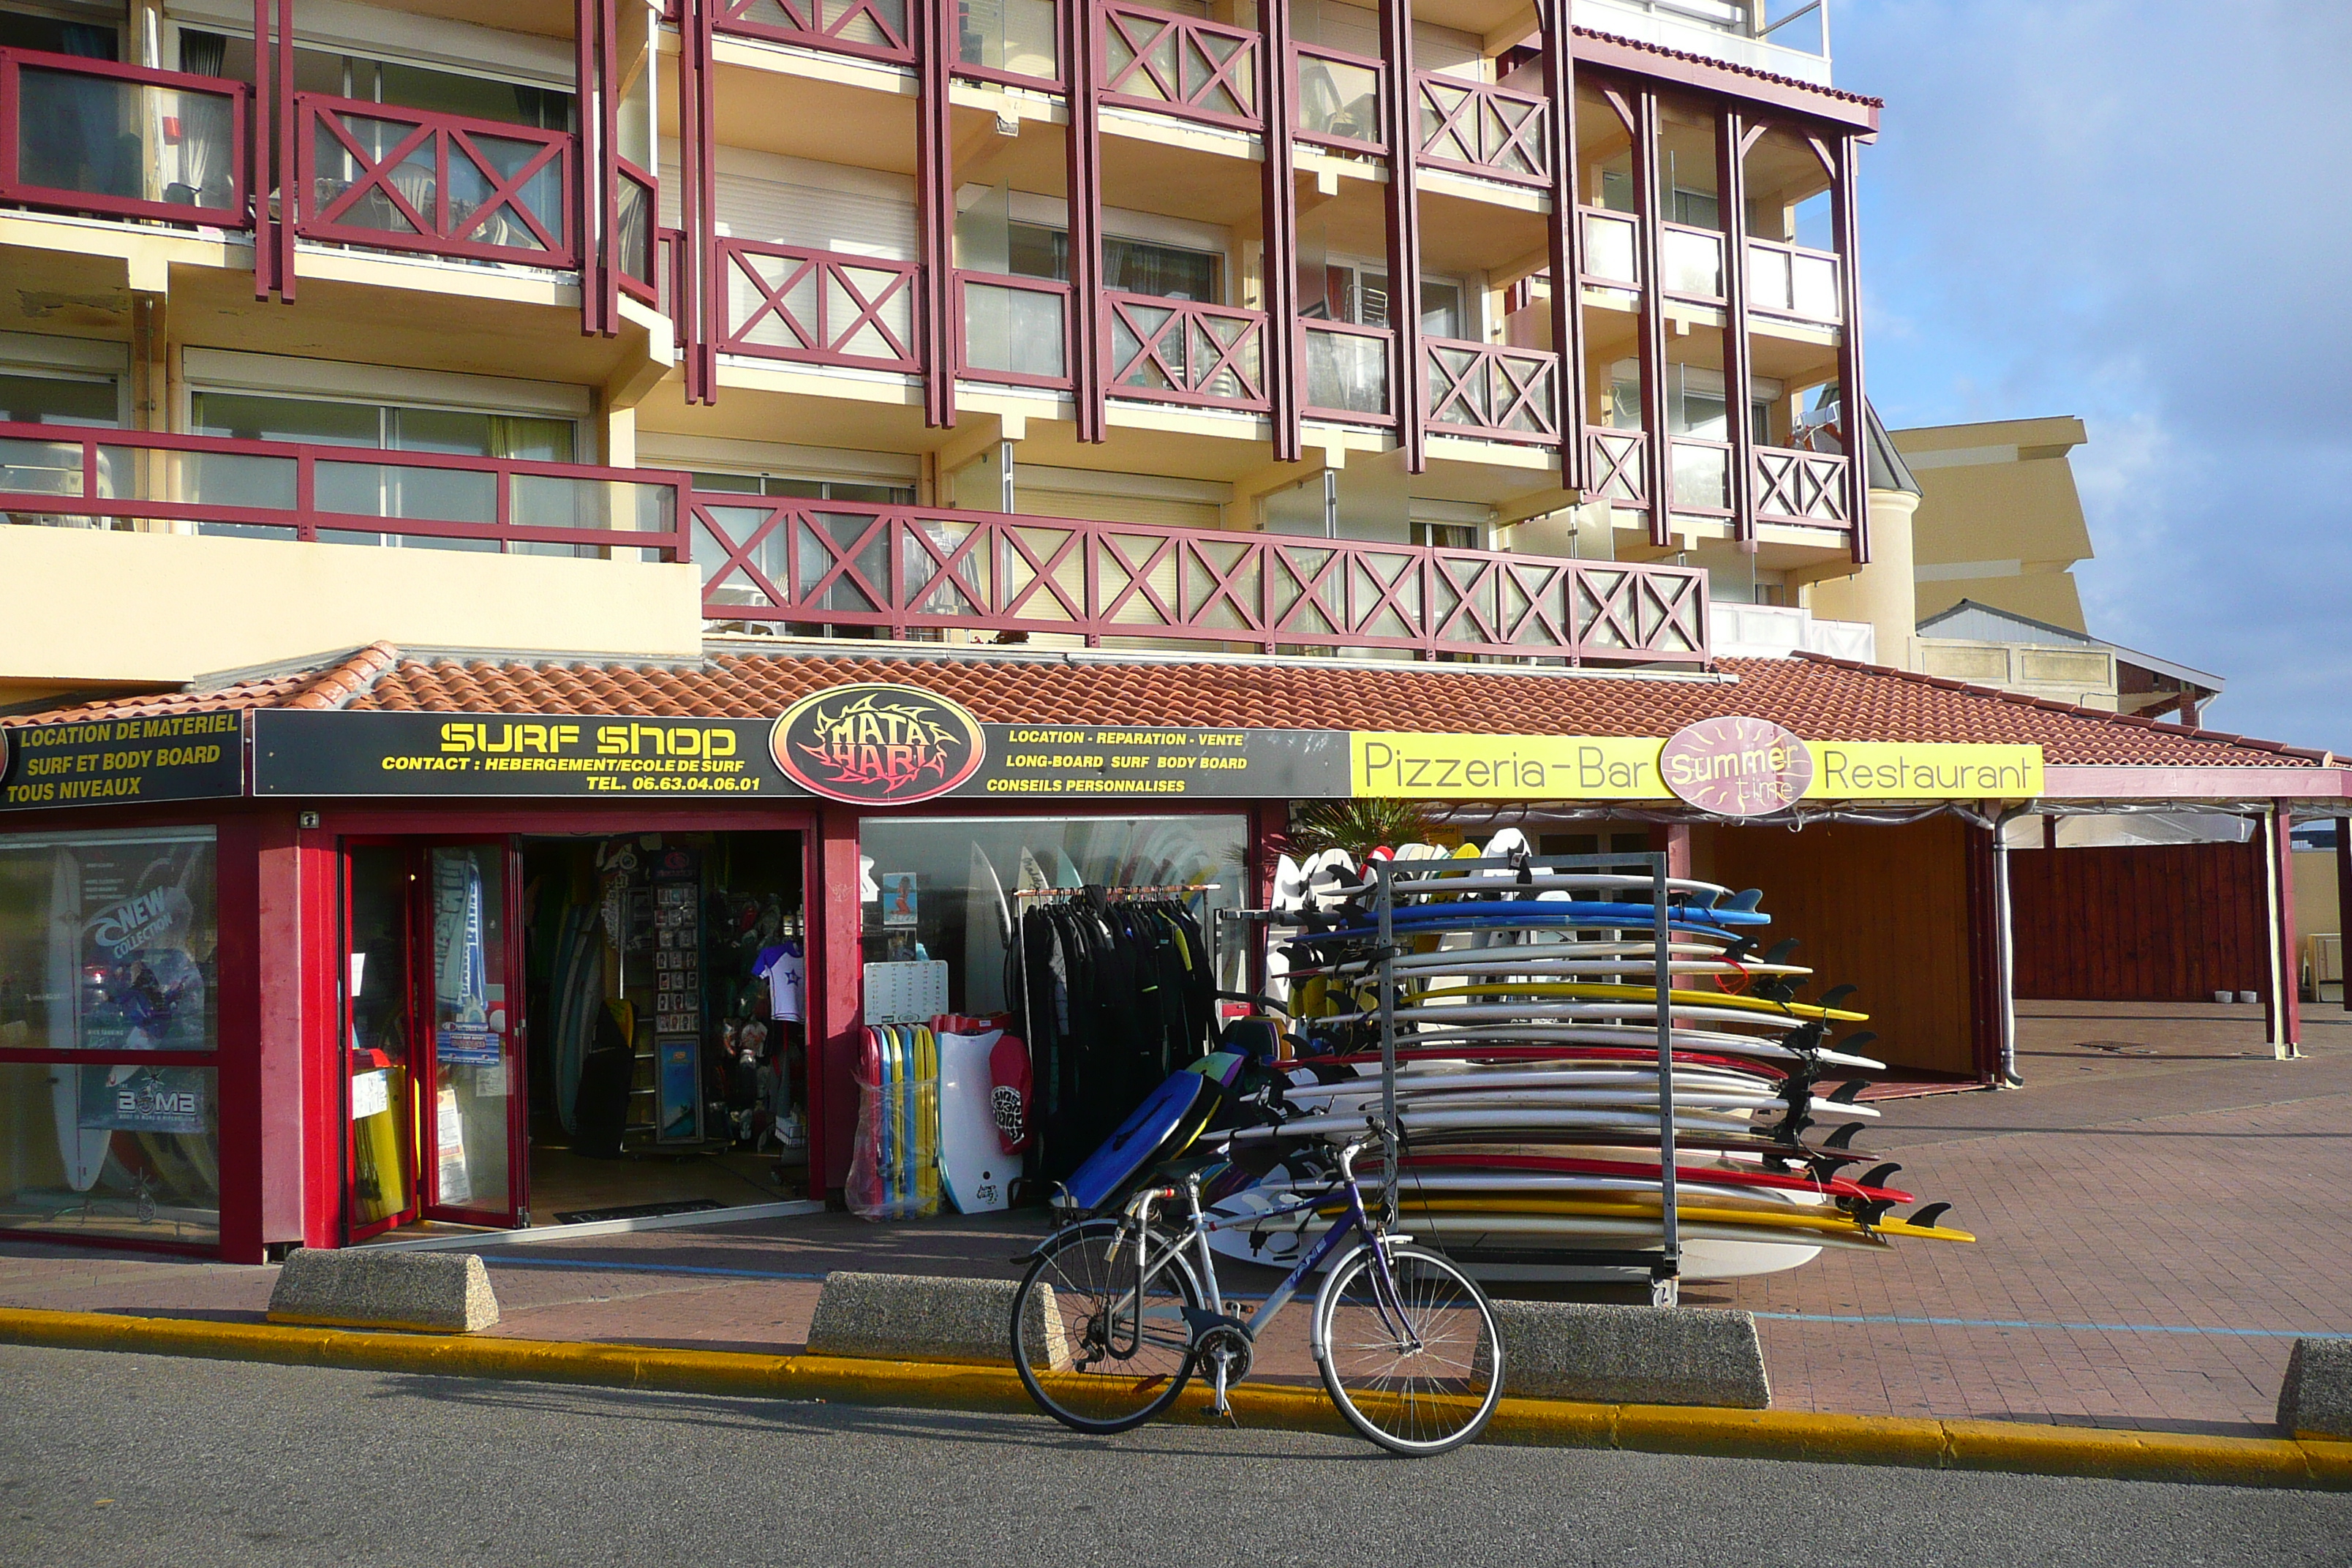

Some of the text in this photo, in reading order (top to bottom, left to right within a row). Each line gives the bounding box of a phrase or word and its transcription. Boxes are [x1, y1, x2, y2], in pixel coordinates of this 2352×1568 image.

[20, 714, 238, 747] LOCATION DE MATERIEL
[441, 723, 580, 753] SURF
[831, 712, 930, 745] MATA
[1009, 730, 1085, 744] LOCATION
[1096, 732, 1187, 745] REPARATION
[1199, 734, 1244, 747] VENTE
[28, 745, 221, 776] SURF ET BODY BOARD
[382, 756, 470, 770] CONTACT
[485, 758, 674, 772] HEBERGEMENT/ECOLE
[677, 760, 701, 772] DE
[701, 760, 745, 772] SURF
[832, 744, 927, 777] HARI
[1006, 755, 1248, 770] LONG-BOARD SURF BODY BOARD
[1670, 743, 1799, 785] Summer
[1824, 750, 2032, 790] Restaurant
[7, 777, 142, 803] TOUS NIVEAUX
[587, 777, 760, 791] TEL. 06.63.04.06.01
[987, 779, 1186, 793] CONSEILS PERSONNALISES
[1735, 776, 1793, 802] time
[118, 885, 165, 934] NEW
[114, 912, 173, 960] COLLECTION
